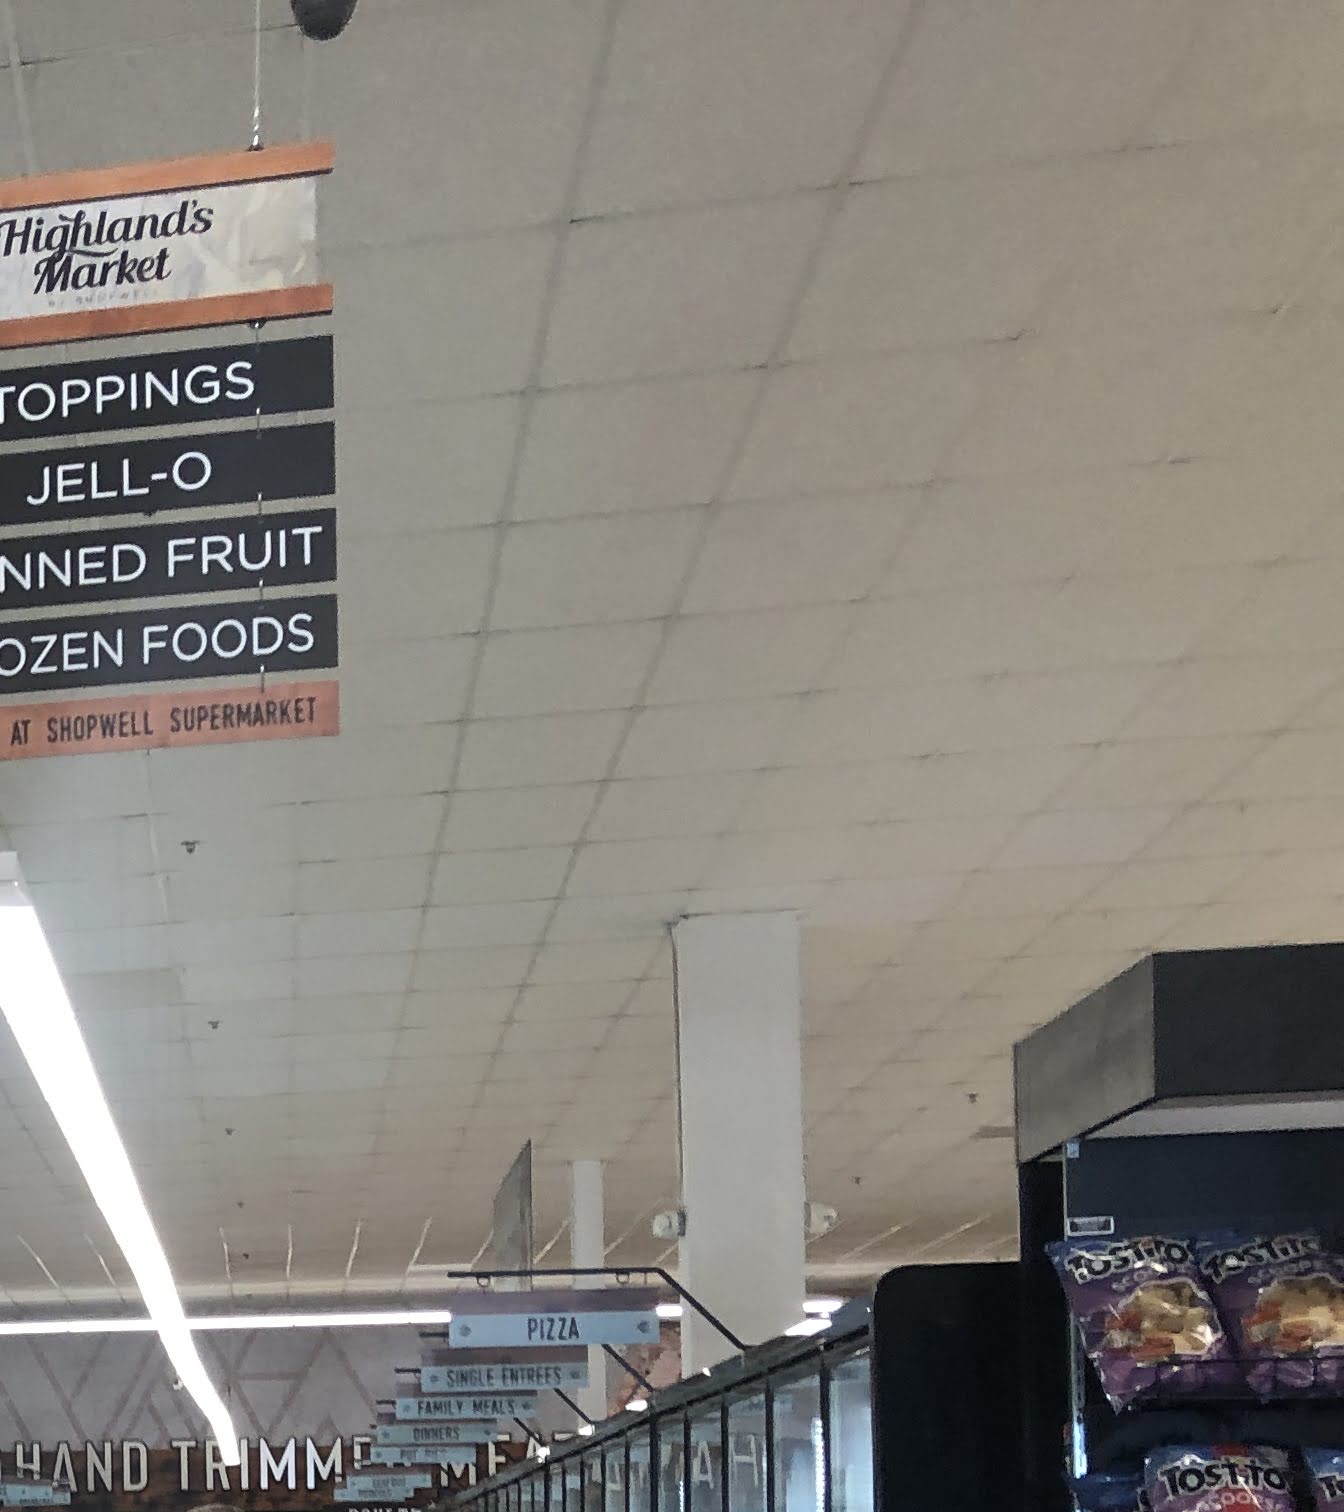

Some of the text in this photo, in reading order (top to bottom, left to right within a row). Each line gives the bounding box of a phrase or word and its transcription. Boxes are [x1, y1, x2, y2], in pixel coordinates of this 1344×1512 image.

[33, 247, 171, 294] Market
[26, 451, 212, 506] JELL-O
[167, 526, 323, 579] FRUIT
[142, 613, 314, 666] FOODS
[11, 719, 33, 745] AT
[46, 710, 155, 744] SHOPWELL
[169, 696, 318, 734] SUPERMARKET
[527, 1316, 580, 1341] PIZZA
[446, 1366, 562, 1388] SINGLE ENTREES
[417, 1400, 516, 1416] FAMILY MEALS
[413, 1427, 460, 1441] DINNERS
[14, 1439, 148, 1493] HAND
[170, 1434, 414, 1492] TRIMME
[1157, 1456, 1291, 1500] TOSTITO
